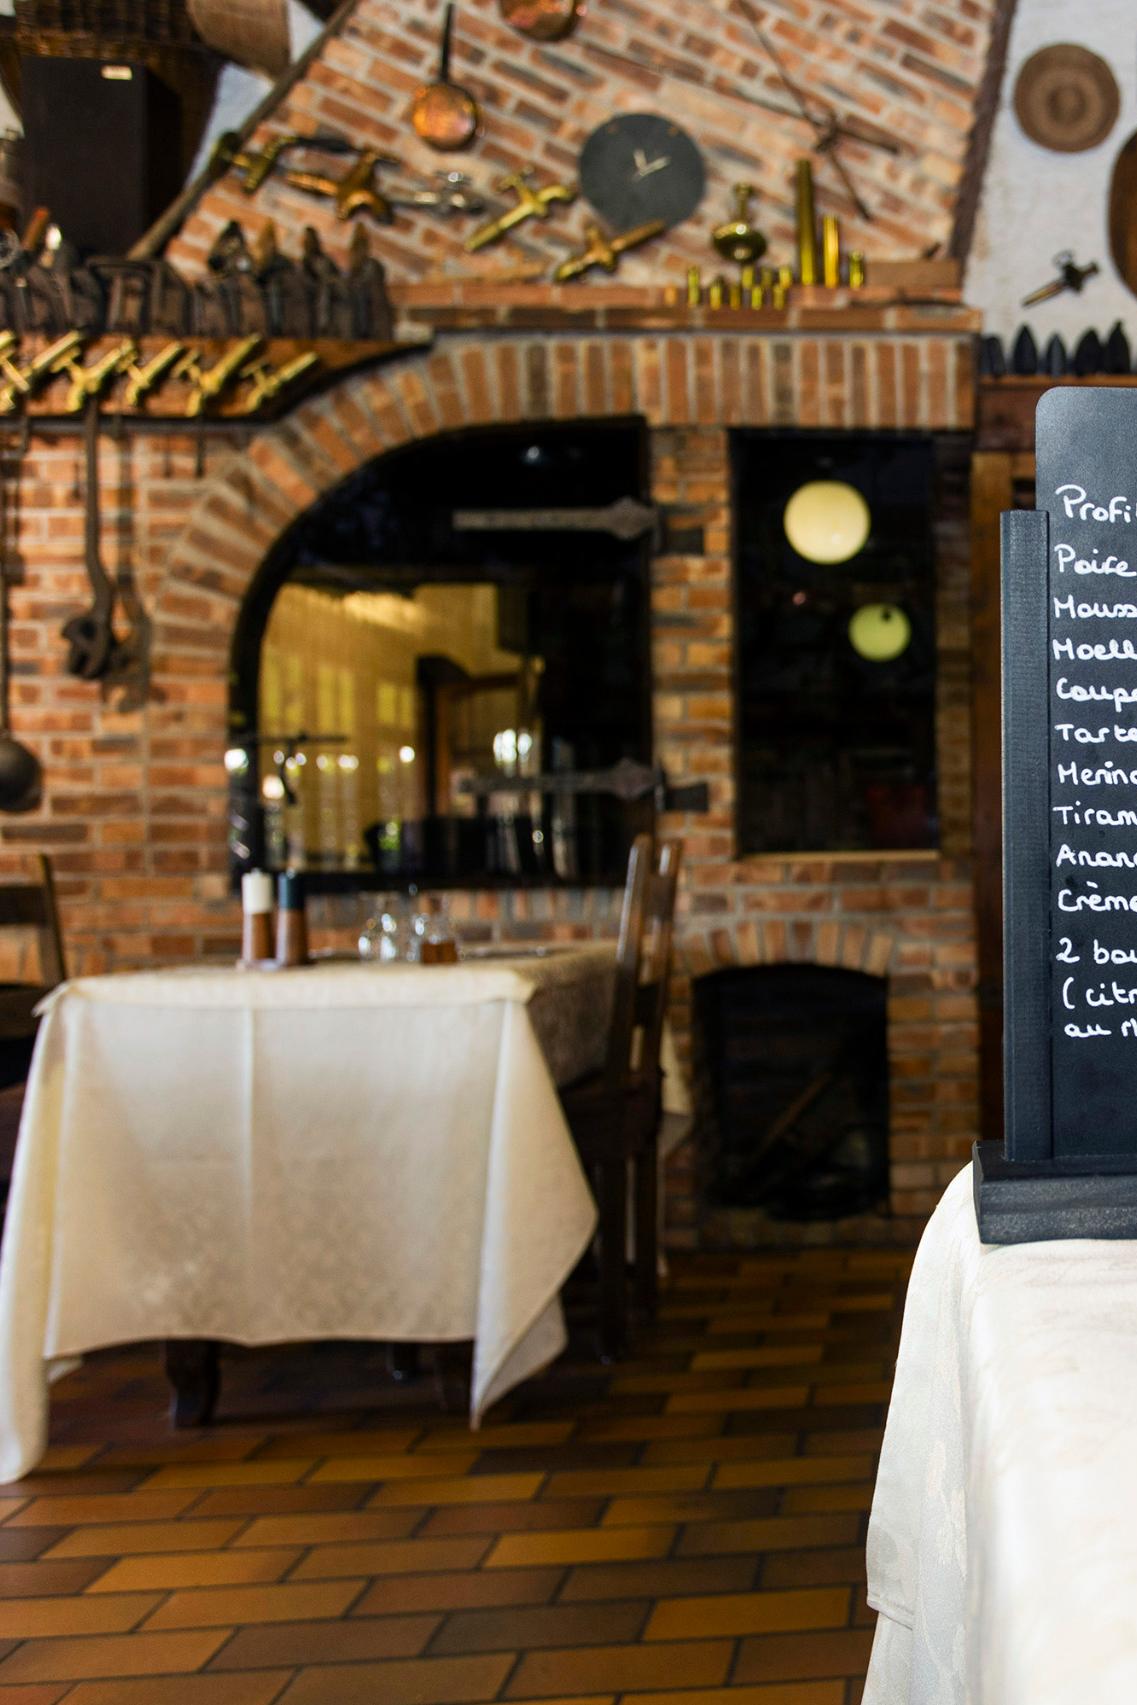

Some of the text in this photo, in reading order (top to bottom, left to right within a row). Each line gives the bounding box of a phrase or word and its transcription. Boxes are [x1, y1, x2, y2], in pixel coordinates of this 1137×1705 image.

[1053, 542, 1137, 578] Poire
[1055, 937, 1081, 964] 2
[1064, 1023, 1112, 1038] au
